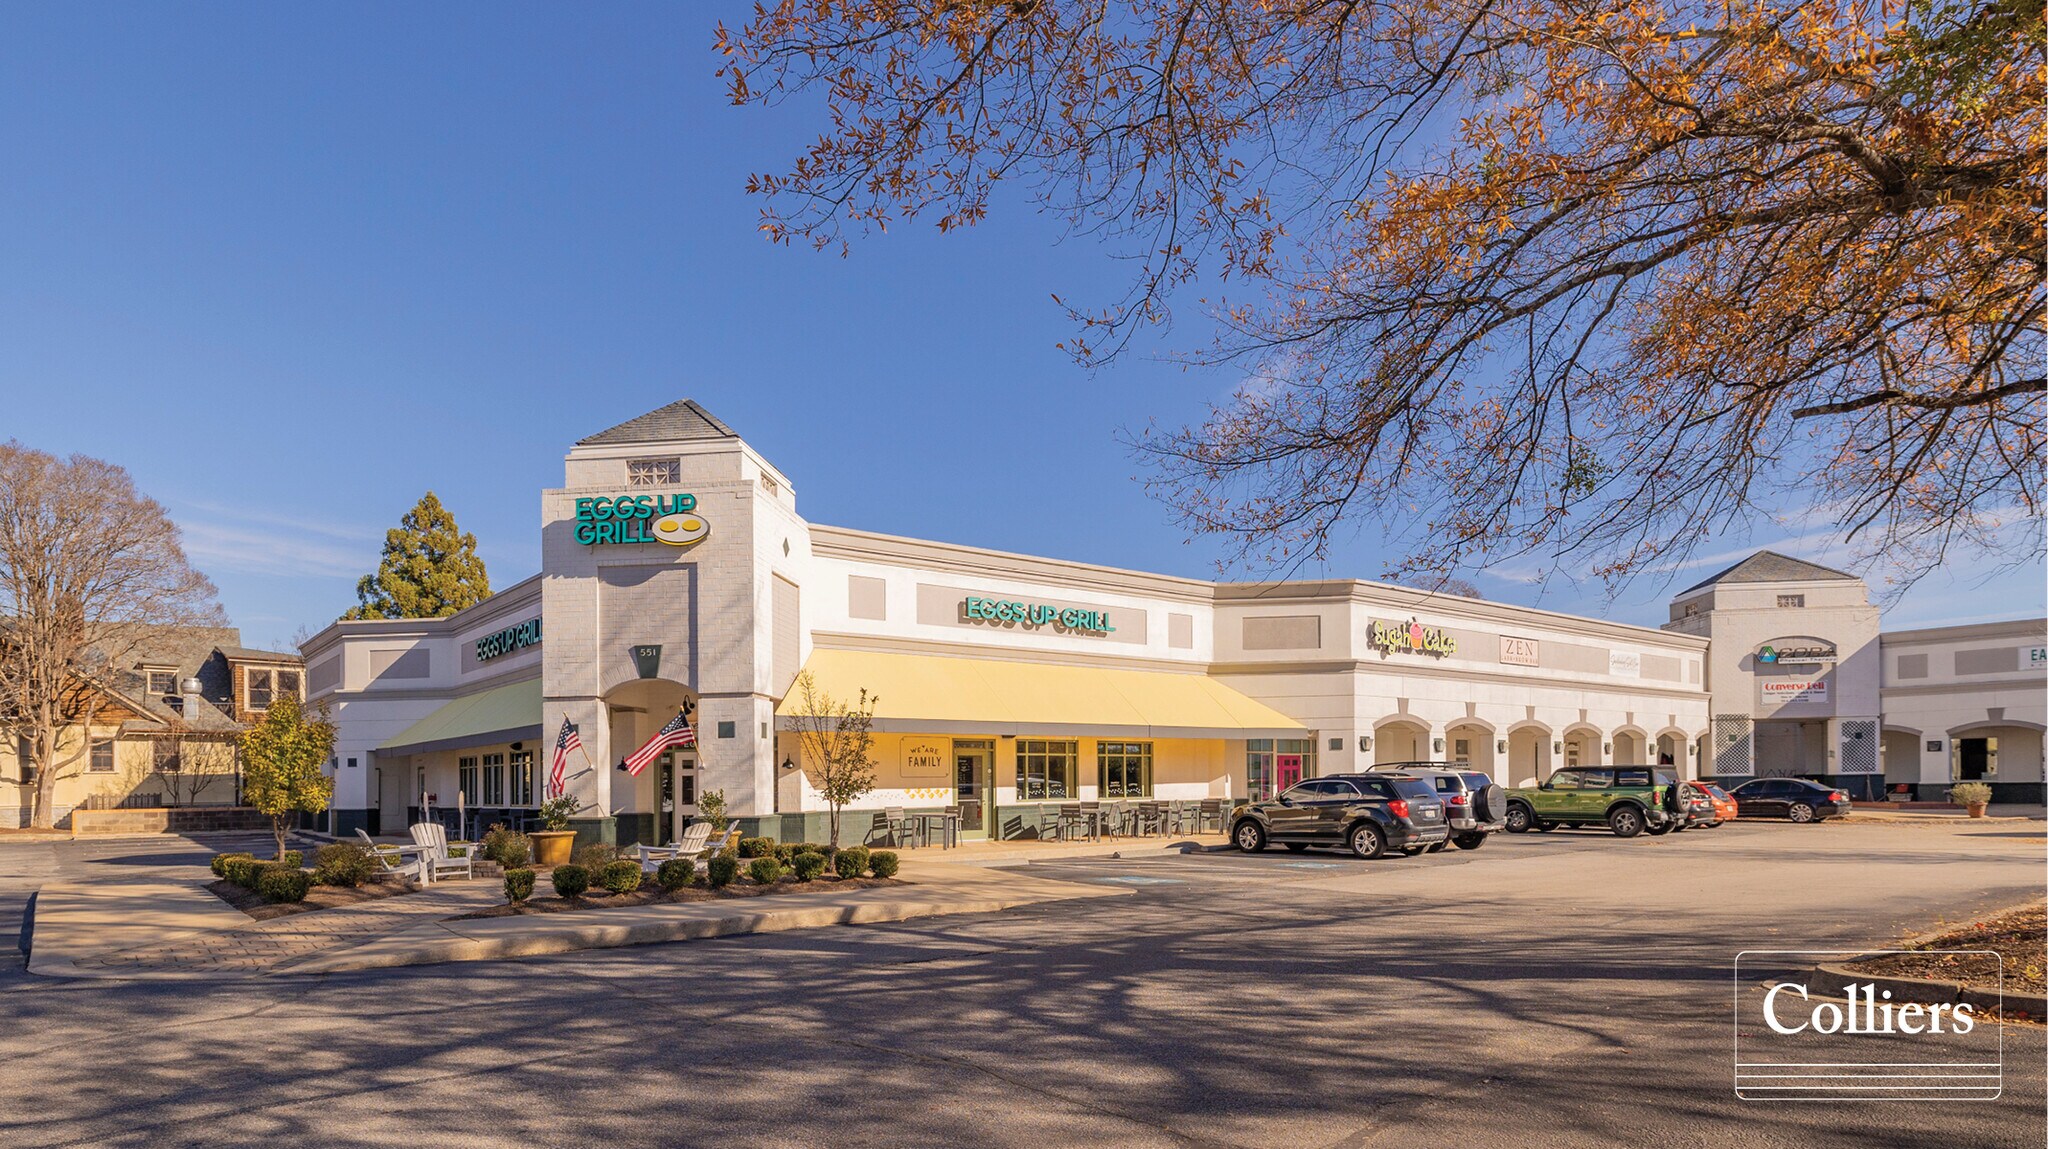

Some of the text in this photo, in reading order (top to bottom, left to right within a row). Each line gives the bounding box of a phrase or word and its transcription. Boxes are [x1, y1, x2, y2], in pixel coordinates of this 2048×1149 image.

[575, 493, 697, 521] EGGS UP
[574, 520, 657, 545] GRILL
[966, 596, 1117, 632] EGGS UP GRILL
[476, 633, 500, 662] EGGS
[501, 628, 514, 654] UP
[1374, 620, 1411, 655] Sugah
[1506, 639, 1533, 656] ZEN
[640, 649, 656, 657] 551
[1807, 681, 1824, 690] Deli
[908, 756, 942, 767] FAMILY
[924, 747, 939, 755] ARE
